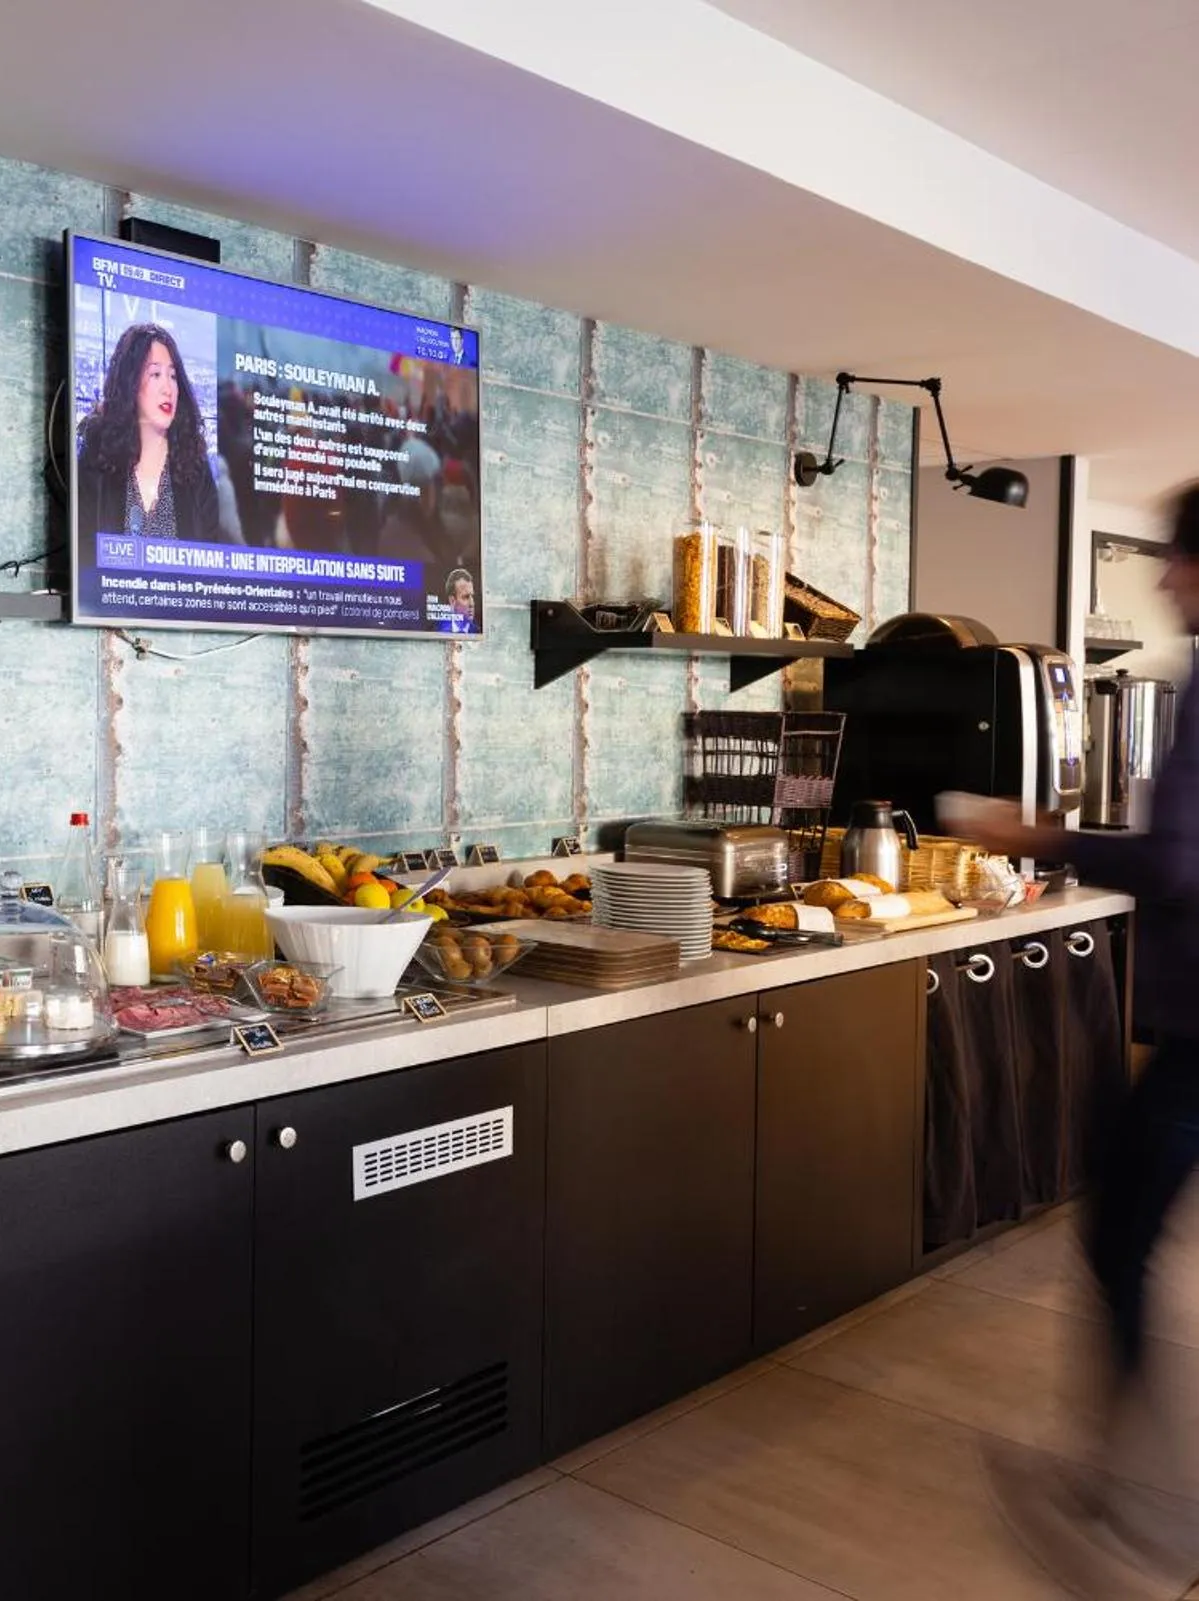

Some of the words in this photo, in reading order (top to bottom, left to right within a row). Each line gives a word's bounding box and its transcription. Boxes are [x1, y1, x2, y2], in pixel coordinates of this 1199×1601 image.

[92, 257, 119, 275] BFM
[150, 271, 182, 287] DIRECT
[235, 353, 277, 378] PARIS
[284, 363, 366, 394] SOULEYMAN
[367, 380, 381, 396] A.
[254, 392, 306, 414] Souleyman
[319, 404, 341, 420] avait
[342, 407, 357, 421] été
[358, 409, 384, 425] arrêté
[385, 415, 406, 429] avec
[406, 418, 427, 434] deux
[254, 408, 284, 424] autres
[286, 412, 347, 434] manifestants
[254, 427, 274, 442] L'un
[274, 429, 292, 445] des
[294, 433, 317, 448] deux
[318, 438, 347, 453] autres
[348, 442, 363, 456] est
[363, 445, 410, 463] soupçonné
[254, 444, 287, 458] d'avoir
[288, 448, 326, 465] incendié
[328, 455, 344, 468] une
[345, 455, 382, 472] poubelle
[254, 463, 262, 476] Il
[262, 466, 284, 480] sera
[285, 468, 306, 484] jugé
[306, 472, 355, 490] aujourd'hui
[356, 478, 367, 490] en
[368, 480, 421, 498] comparution
[312, 483, 337, 499] Paris
[146, 544, 224, 569] SOULEYMAN
[231, 552, 255, 571] UNE
[256, 554, 345, 578] INTERPELLATION
[345, 561, 374, 581] SANS
[377, 565, 405, 583] SUITE
[101, 575, 149, 590] Incendie
[150, 579, 177, 592] dans
[178, 580, 193, 593] les
[194, 582, 294, 600] Pyrénées-Orientales
[318, 590, 343, 602] travail
[344, 593, 382, 605] minutieux
[383, 596, 403, 605] nous
[101, 591, 138, 606] attend,
[138, 595, 183, 608] certaines
[184, 599, 212, 609] zones
[213, 600, 226, 609] ne
[227, 600, 247, 611] sont
[248, 602, 298, 614] accessibles
[372, 607, 382, 618] de
